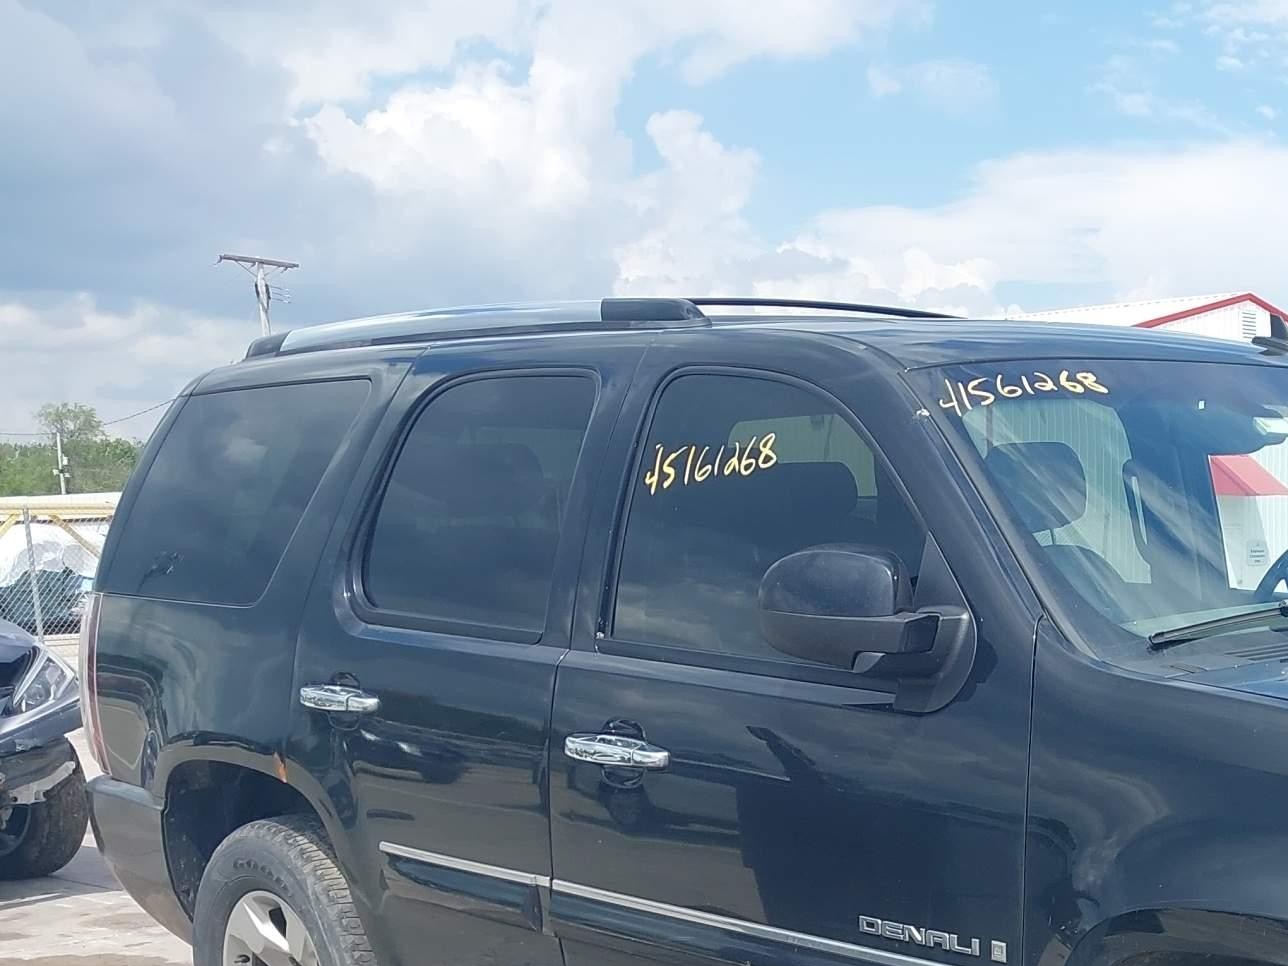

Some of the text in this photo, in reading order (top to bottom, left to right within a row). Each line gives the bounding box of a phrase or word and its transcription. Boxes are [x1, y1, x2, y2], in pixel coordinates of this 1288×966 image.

[939, 370, 1109, 417] 41561268
[644, 432, 778, 496] 45161268
[858, 914, 981, 957] DENALI
